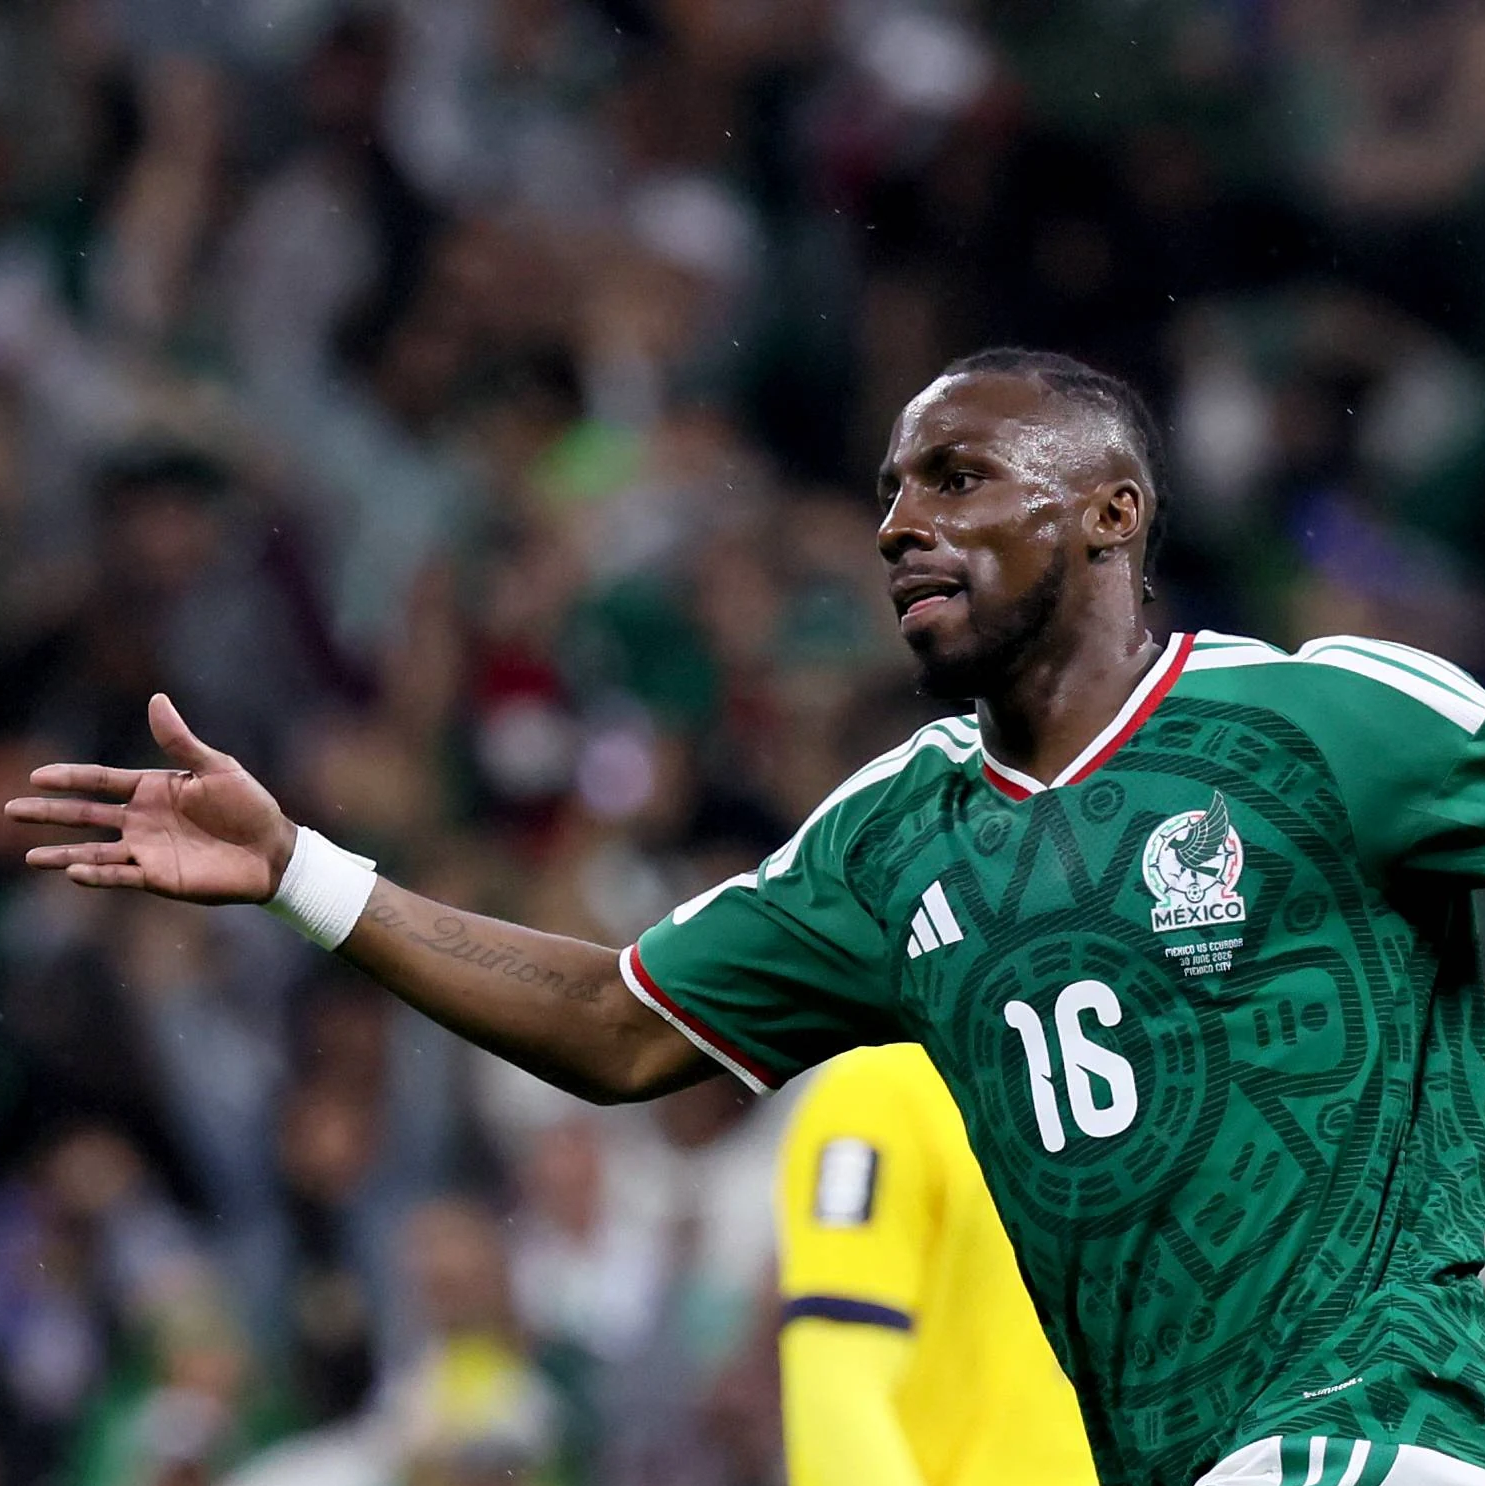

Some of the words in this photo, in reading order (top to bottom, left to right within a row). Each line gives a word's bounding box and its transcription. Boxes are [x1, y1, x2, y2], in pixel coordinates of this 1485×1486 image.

[1153, 901, 1242, 929] MÉXICO
[1212, 951, 1233, 962] 2026
[1216, 961, 1232, 973] CITY
[1003, 979, 1138, 1153] 16
